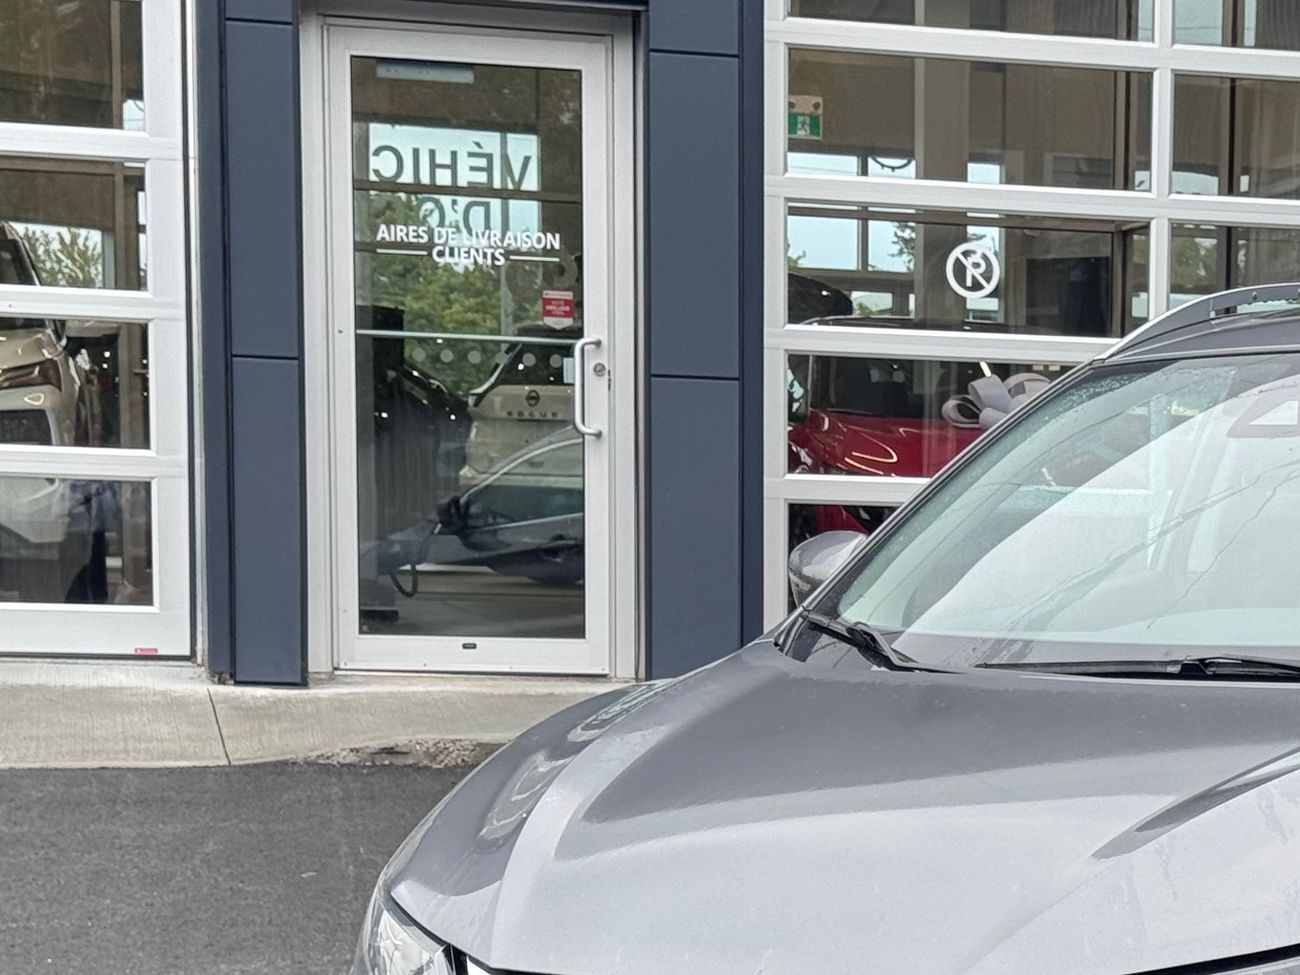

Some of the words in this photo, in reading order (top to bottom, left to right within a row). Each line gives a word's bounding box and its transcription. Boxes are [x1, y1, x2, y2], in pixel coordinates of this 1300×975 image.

[376, 224, 428, 243] AIRES
[433, 228, 457, 245] DE
[462, 229, 561, 250] LIVRAISON
[431, 246, 506, 266] CLIENTS
